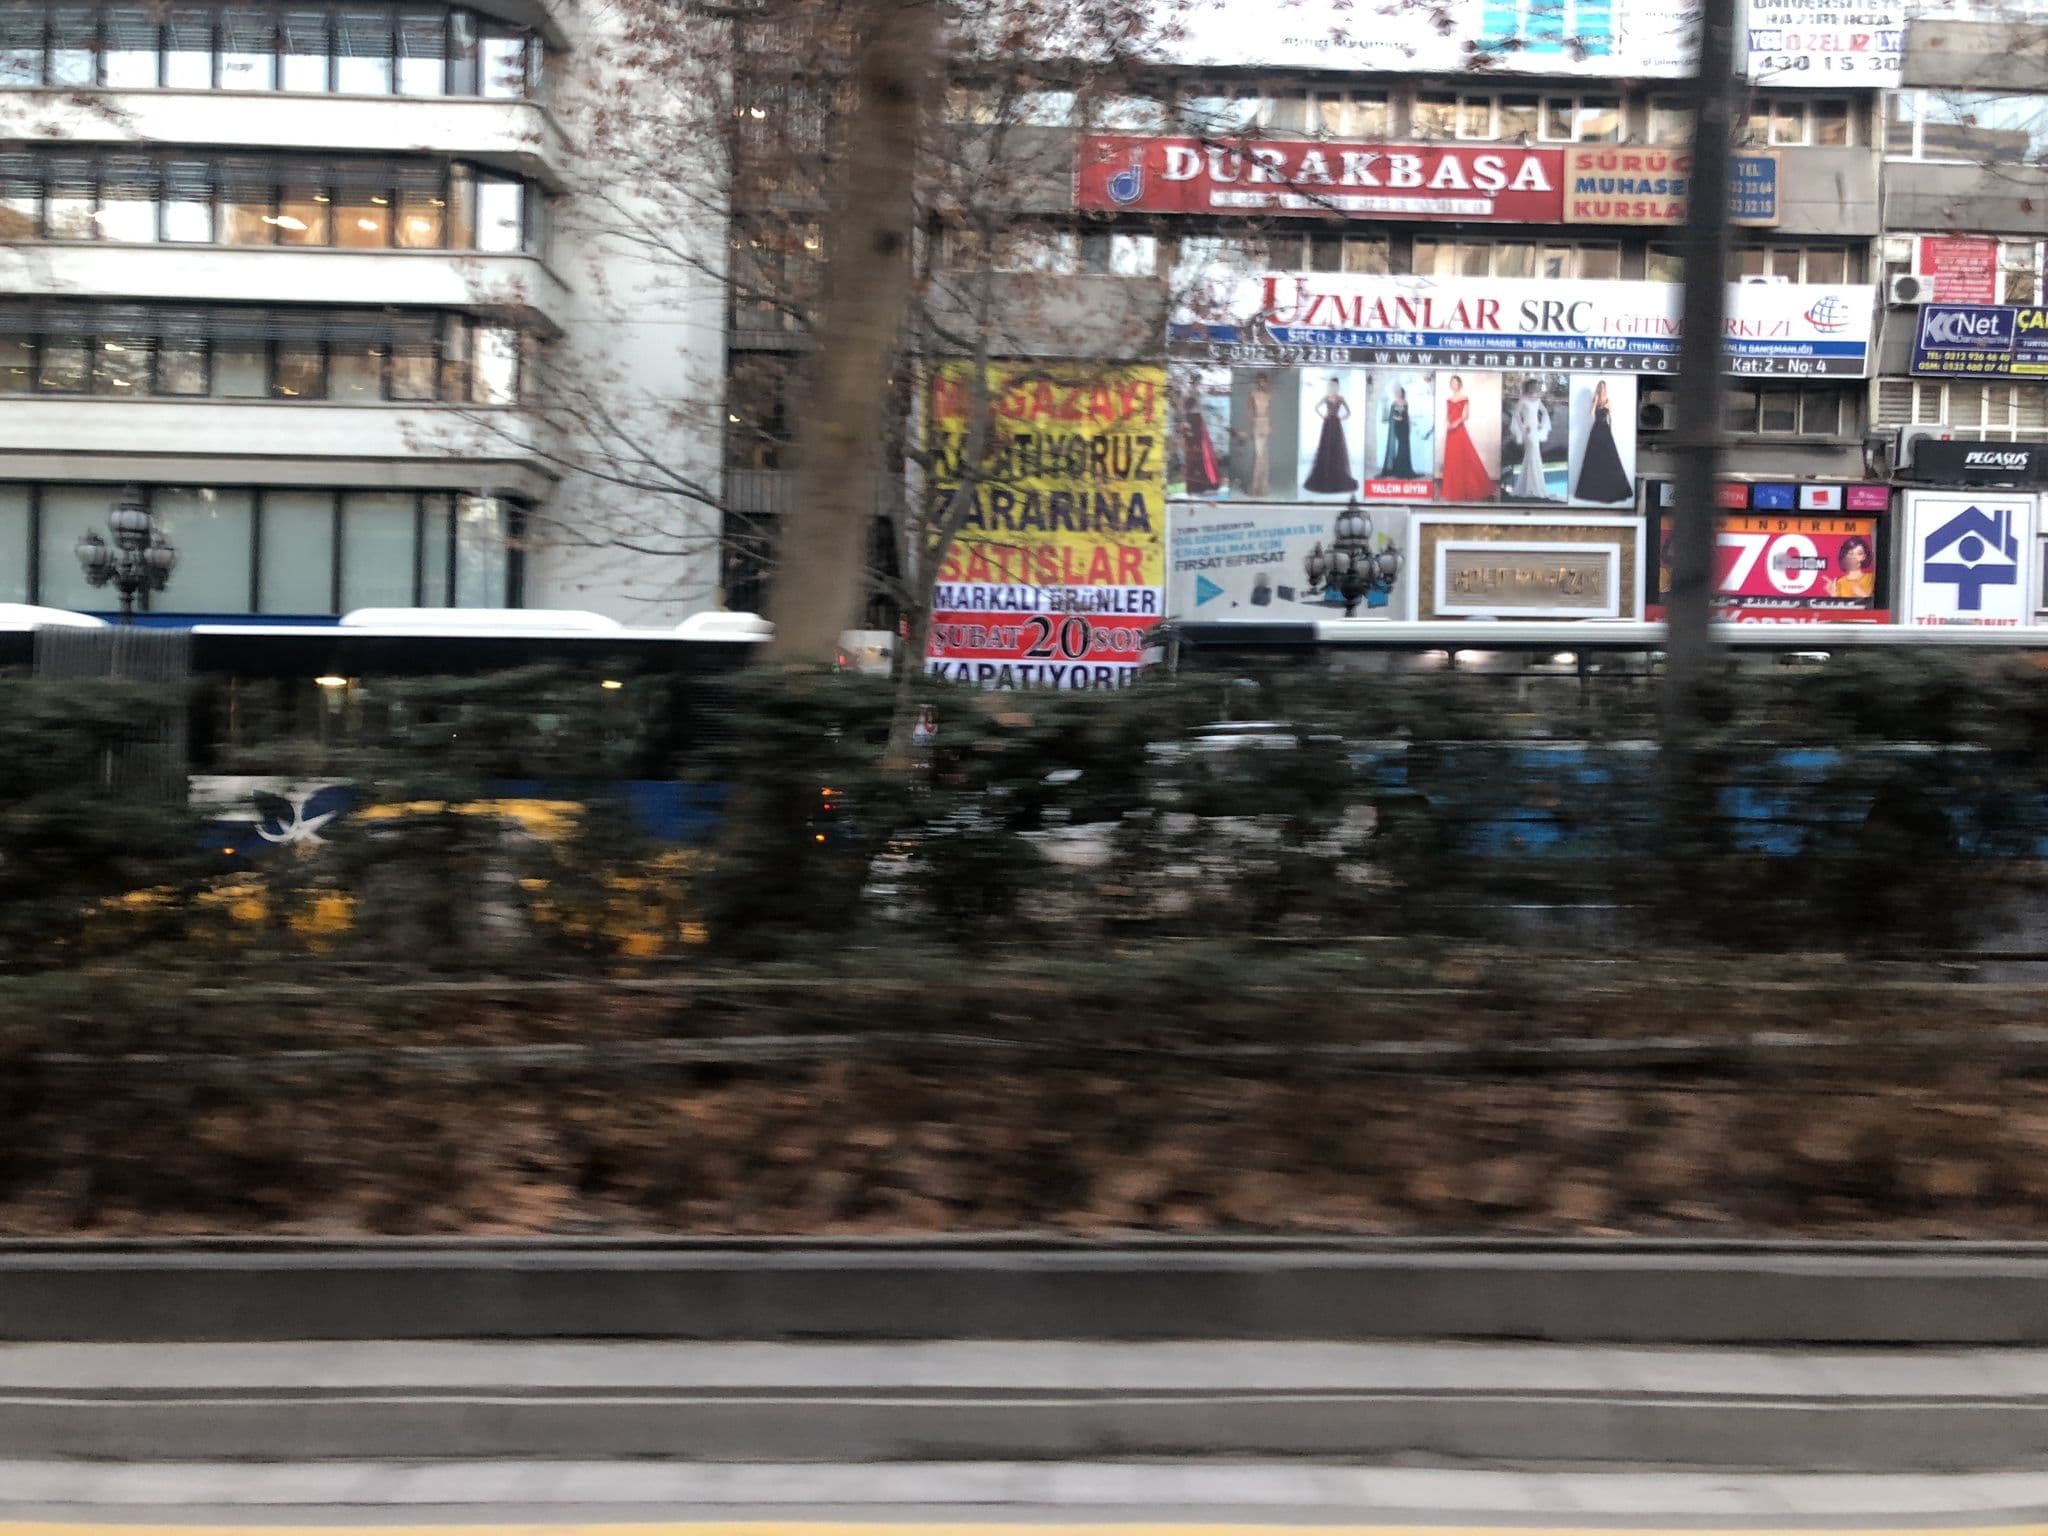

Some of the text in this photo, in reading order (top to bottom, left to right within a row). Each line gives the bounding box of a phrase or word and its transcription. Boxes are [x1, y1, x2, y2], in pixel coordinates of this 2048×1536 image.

[1162, 145, 1553, 197] DURAKBAŞA
[1575, 151, 1691, 172] SÜRÜC
[1575, 177, 1686, 195] MUHASE
[1573, 200, 1685, 218] KURSLA
[1262, 277, 1502, 332] UZMANLAR
[1519, 298, 1595, 335] SRC
[1586, 337, 1626, 350] TMGD
[1375, 349, 1680, 370] www.uzmanlarsrc.co
[1964, 452, 2030, 466] PEGASUS
[1175, 556, 1223, 571] FIRSAT
[934, 586, 1040, 612] MARKALI
[1023, 615, 1092, 659] 20
